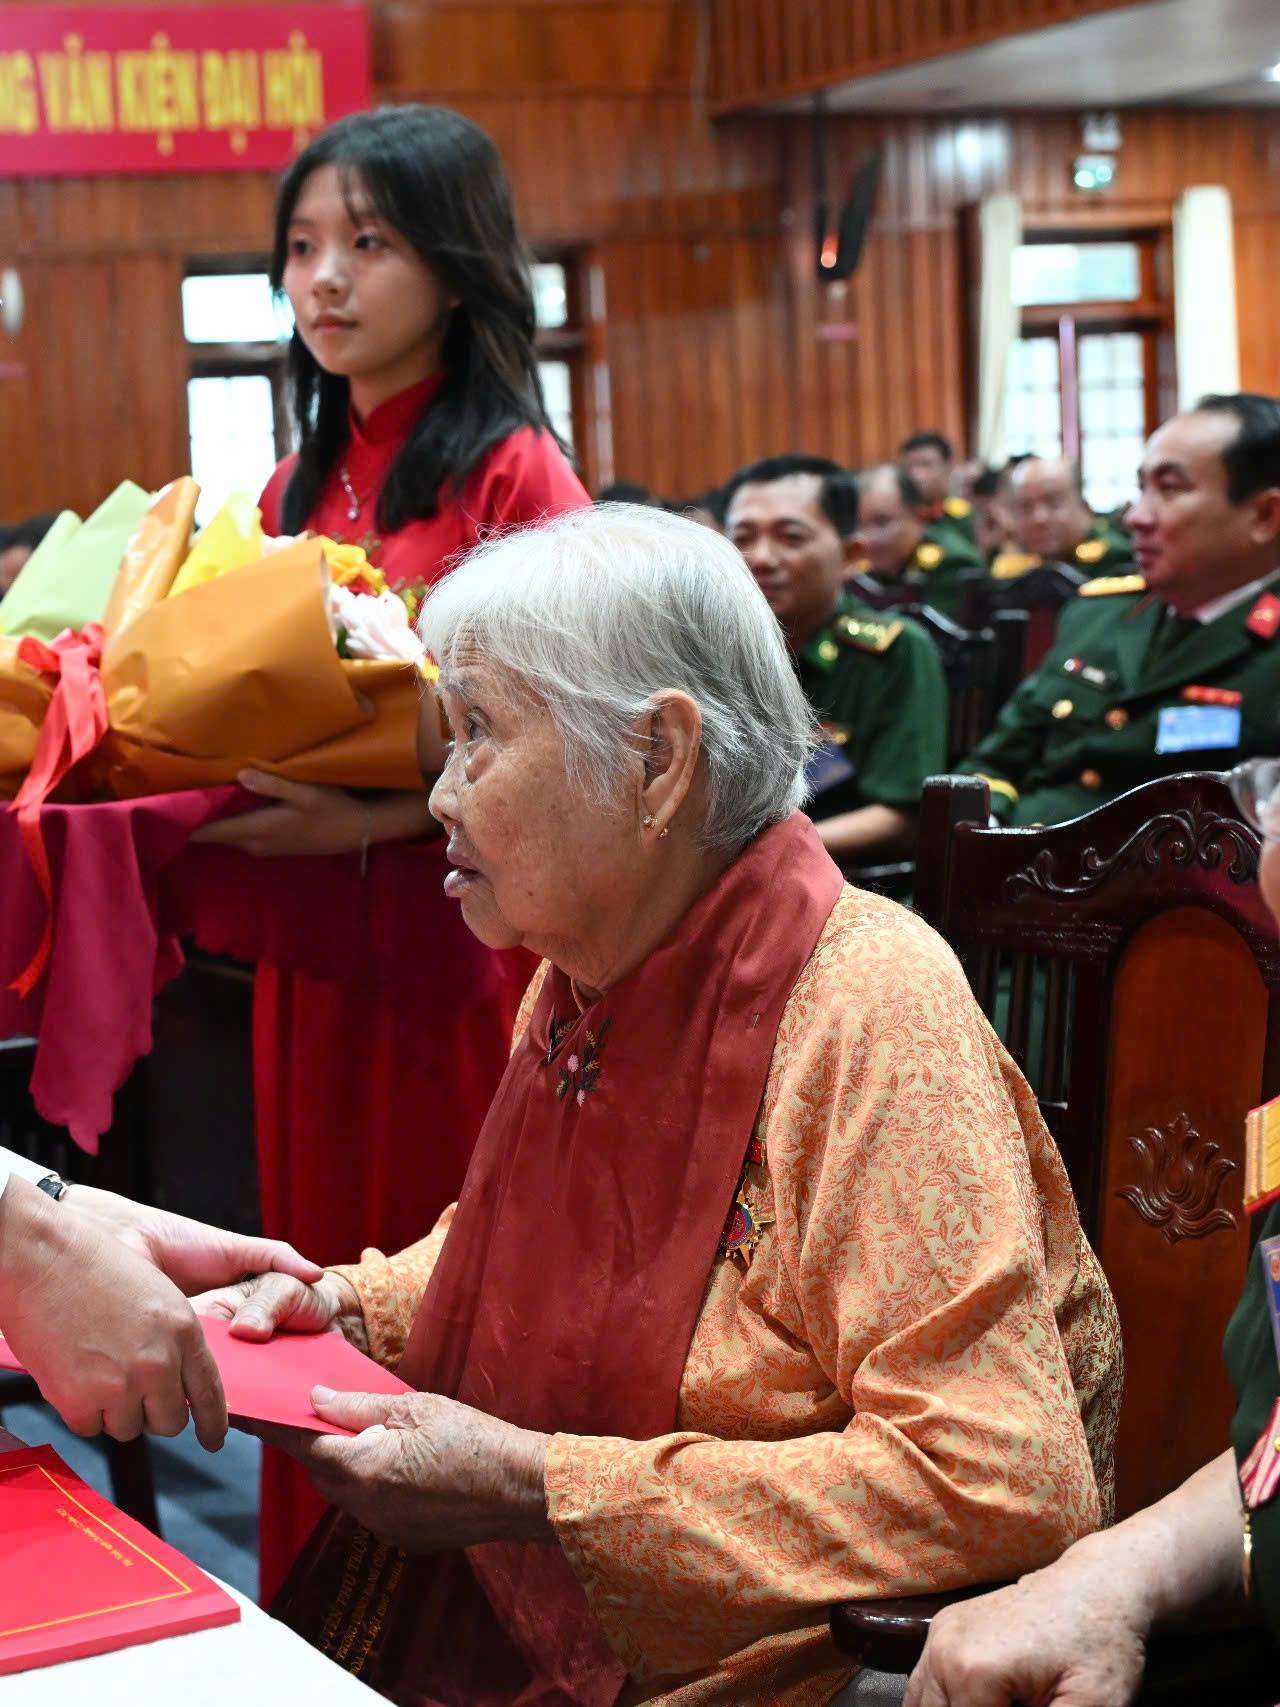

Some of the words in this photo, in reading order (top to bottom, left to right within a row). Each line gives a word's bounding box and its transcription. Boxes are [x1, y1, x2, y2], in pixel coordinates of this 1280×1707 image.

[36, 33, 114, 130] VĂN
[120, 32, 199, 155] KIỆN
[202, 50, 259, 153] ĐẠI
[262, 30, 325, 152] HỘI
